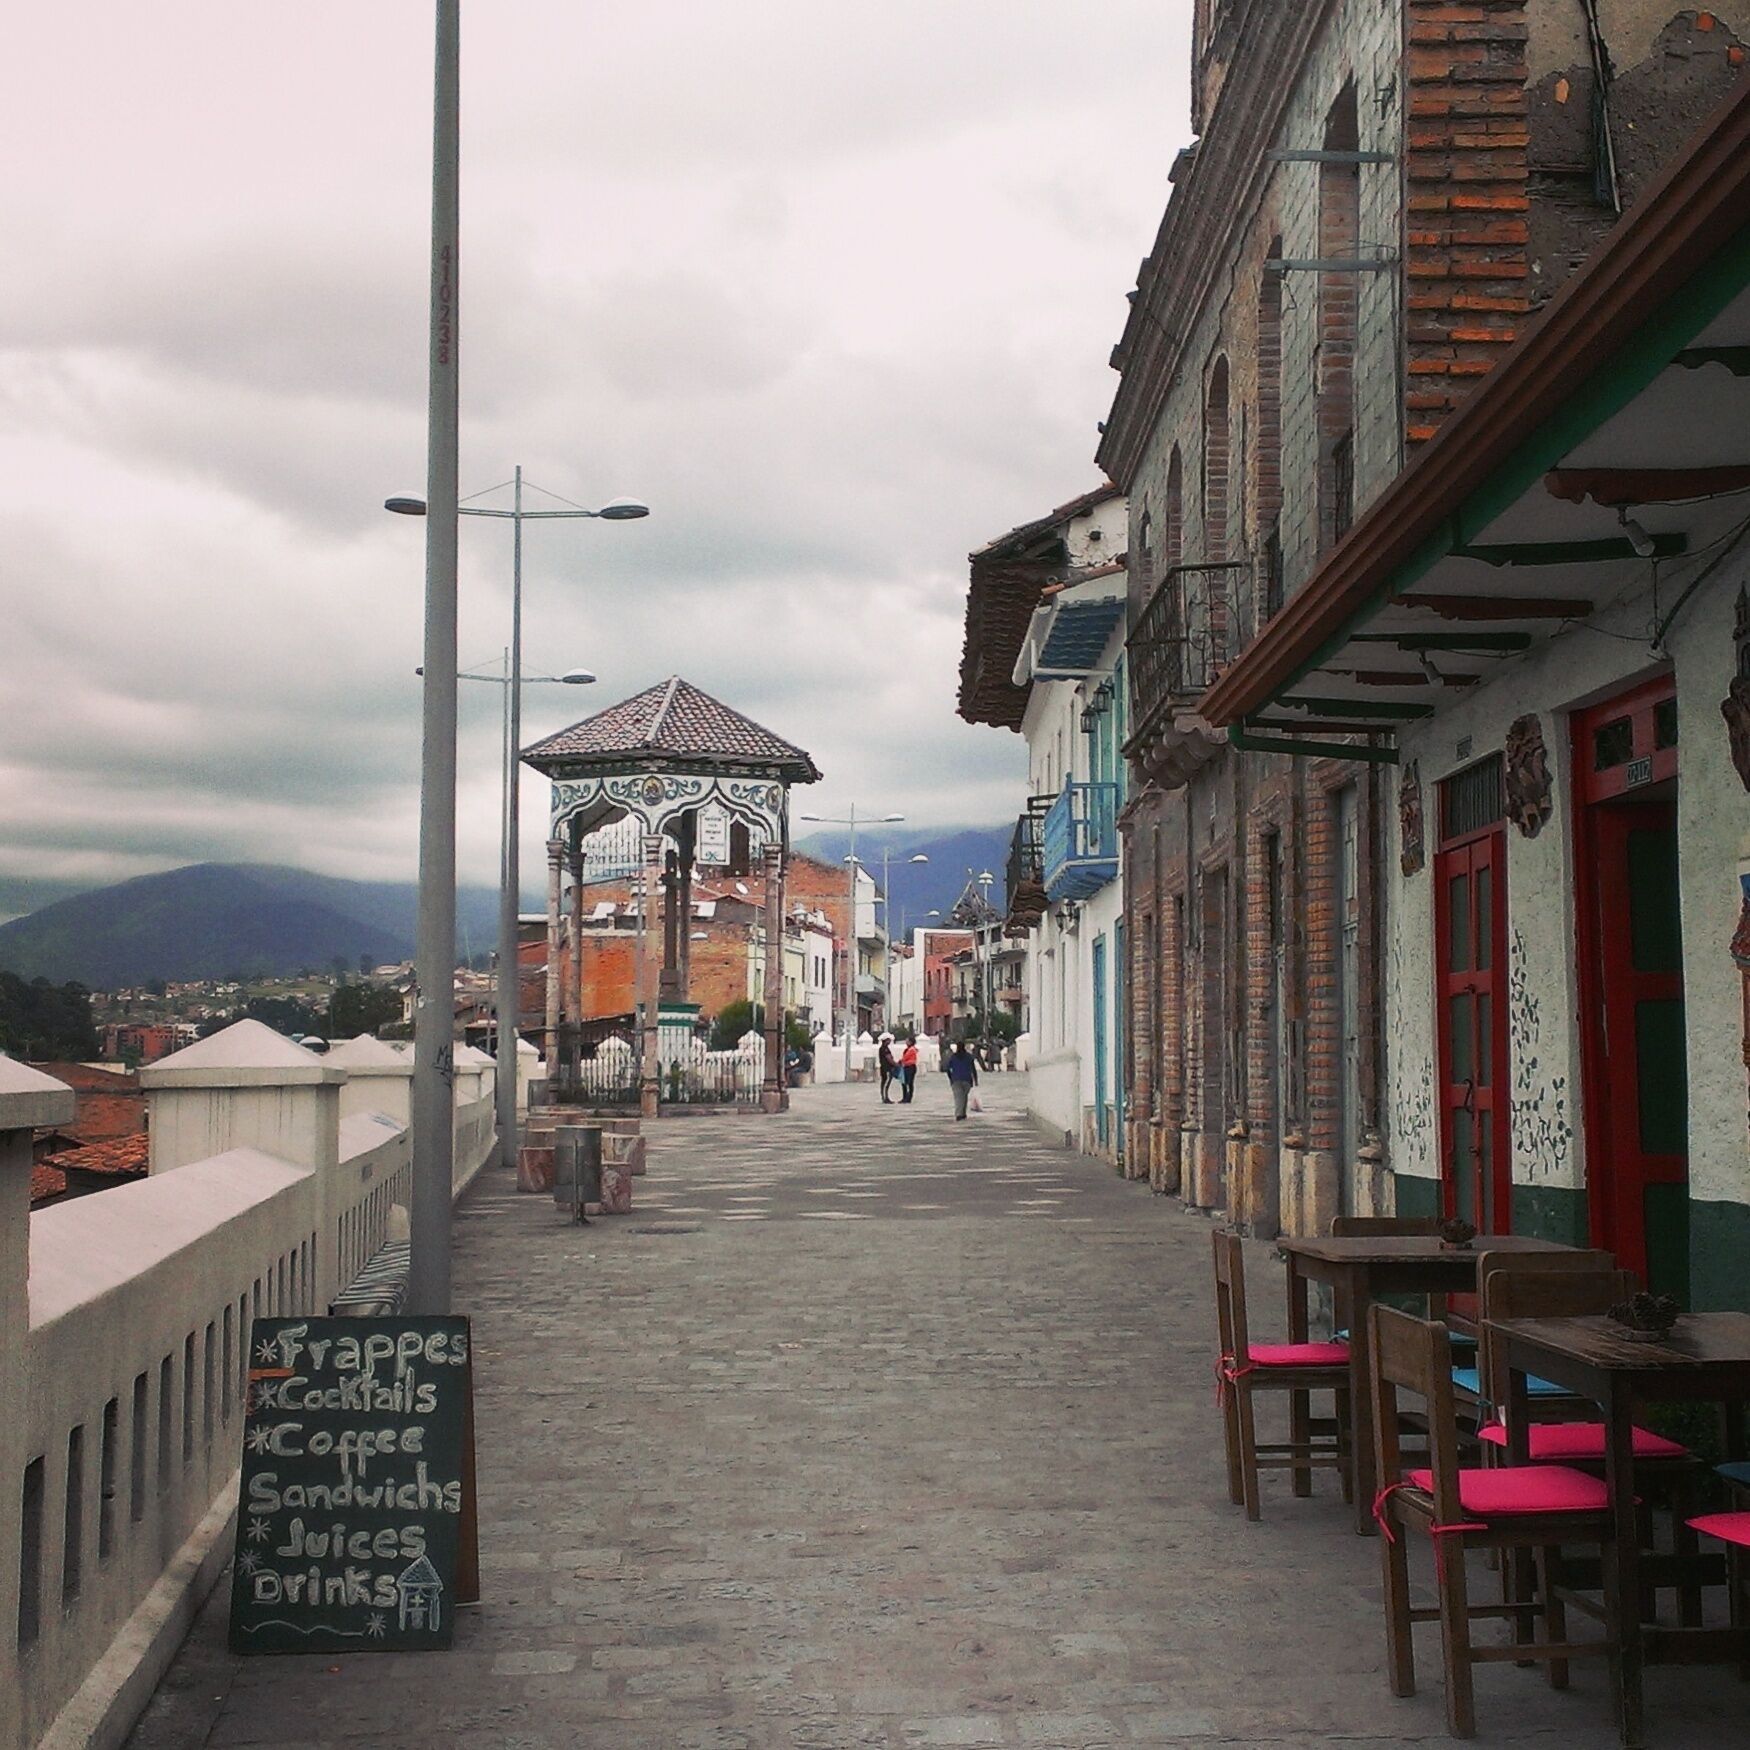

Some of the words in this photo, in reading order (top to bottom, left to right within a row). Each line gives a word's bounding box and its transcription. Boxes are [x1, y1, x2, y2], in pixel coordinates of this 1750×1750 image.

[276, 1324, 467, 1378] Frappes
[277, 1366, 437, 1414] Cocktails
[269, 1423, 425, 1478] Coffee
[248, 1461, 461, 1514] Sandwichs
[276, 1517, 427, 1559] Juices
[250, 1565, 398, 1607] Drinks
